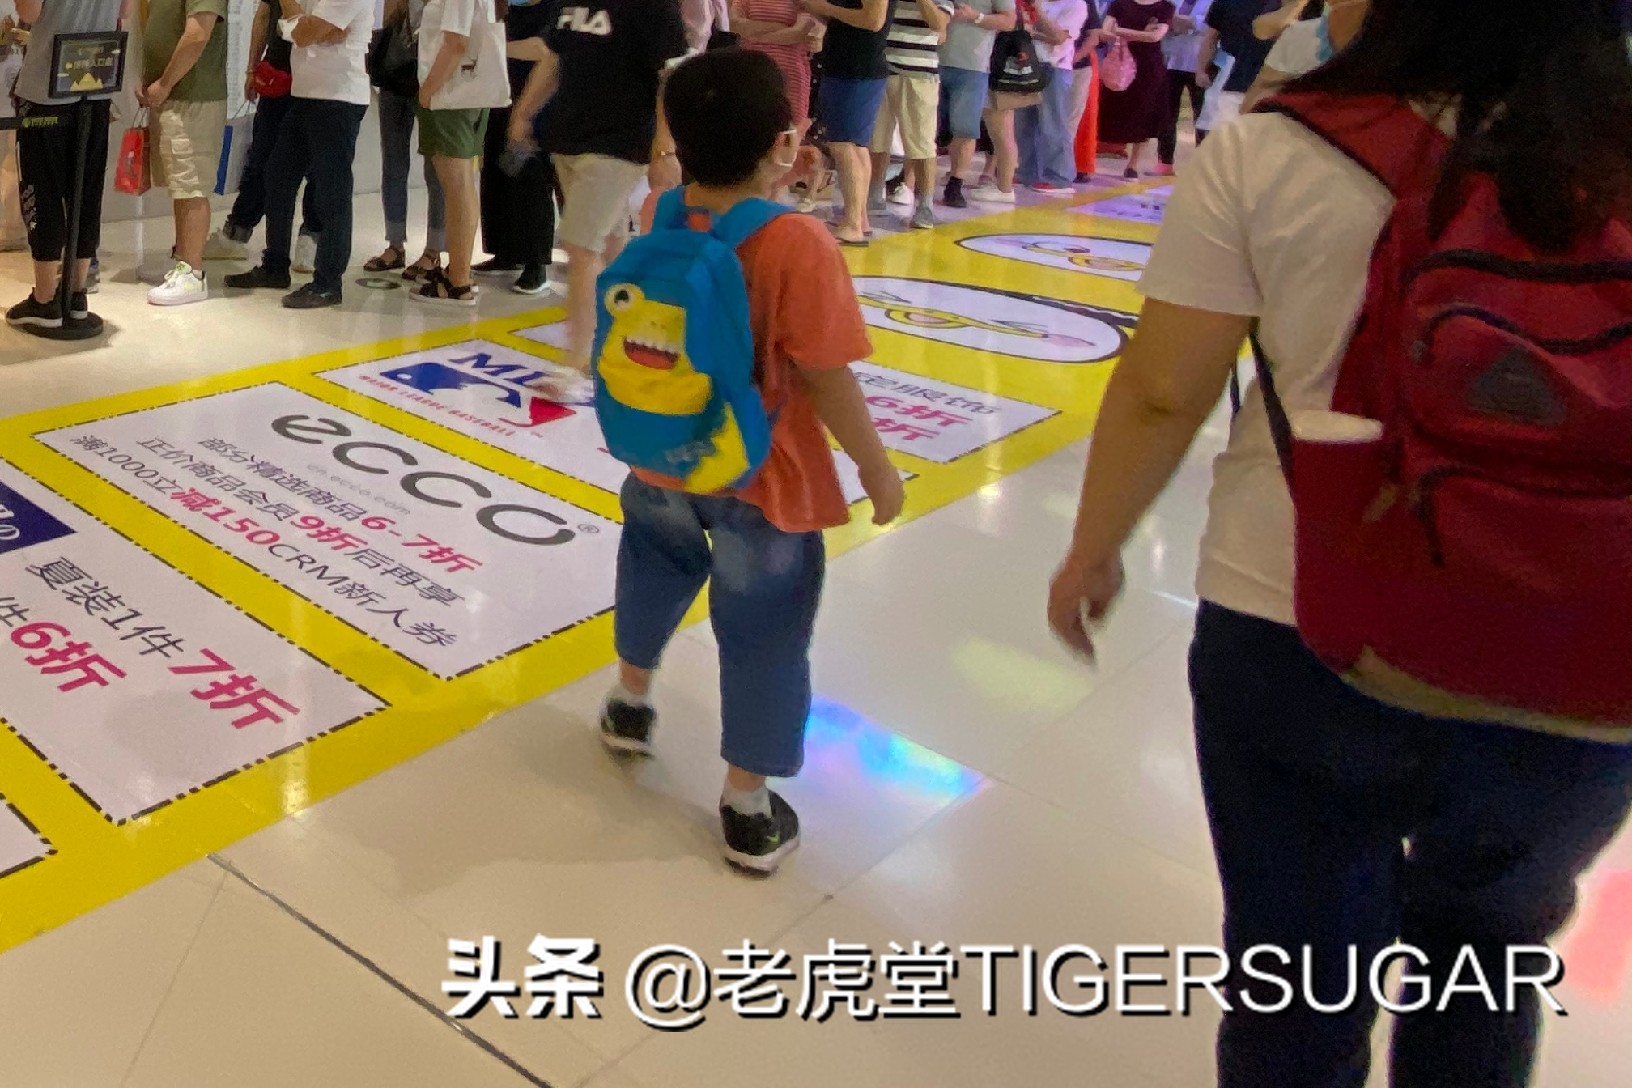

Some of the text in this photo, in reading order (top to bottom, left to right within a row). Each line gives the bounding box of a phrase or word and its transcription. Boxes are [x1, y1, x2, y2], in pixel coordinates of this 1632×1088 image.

[272, 414, 576, 546] ecco
[25, 556, 302, 730] 夏装1件7折
